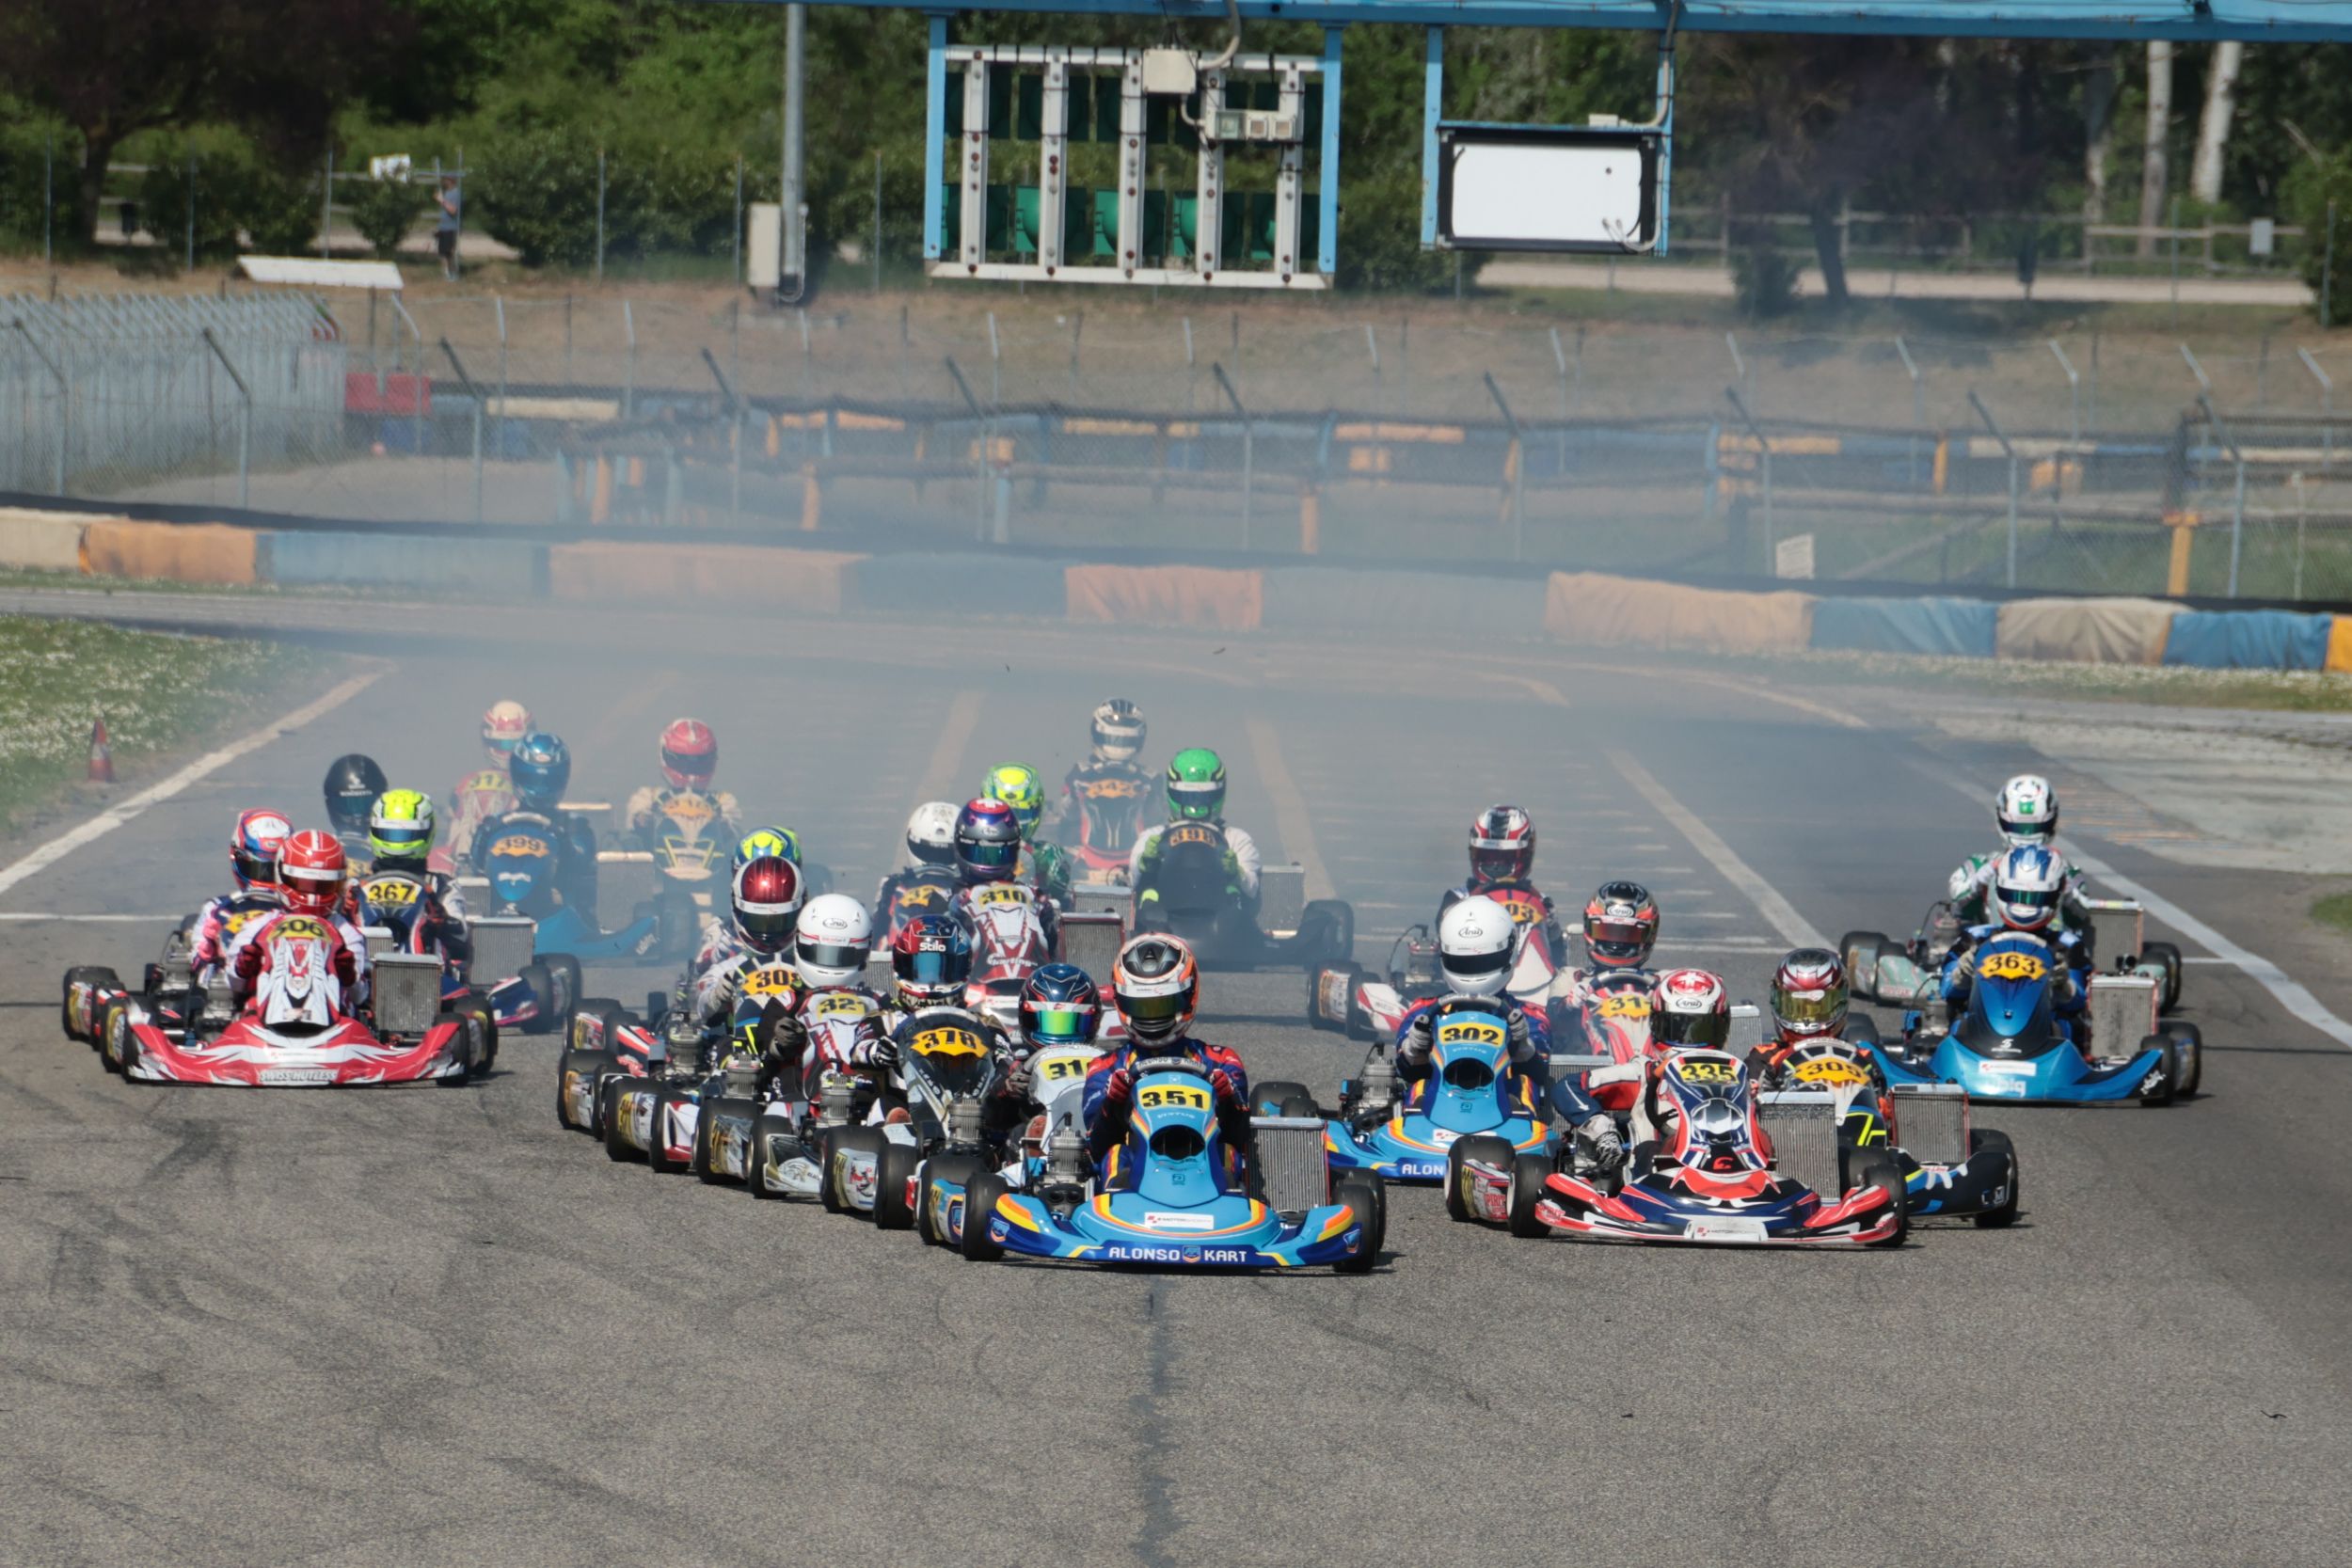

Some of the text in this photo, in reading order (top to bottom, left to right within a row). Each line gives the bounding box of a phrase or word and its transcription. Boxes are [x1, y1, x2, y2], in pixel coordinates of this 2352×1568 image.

[369, 884, 416, 901] 367
[919, 940, 946, 952] Stilo
[1989, 955, 2035, 974] 363
[1444, 1027, 1500, 1045] 302
[1049, 1059, 1090, 1080] 31
[1681, 1065, 1737, 1082] 335
[1142, 1091, 1203, 1109] 351
[1109, 1246, 1247, 1262] ALONSO KART
